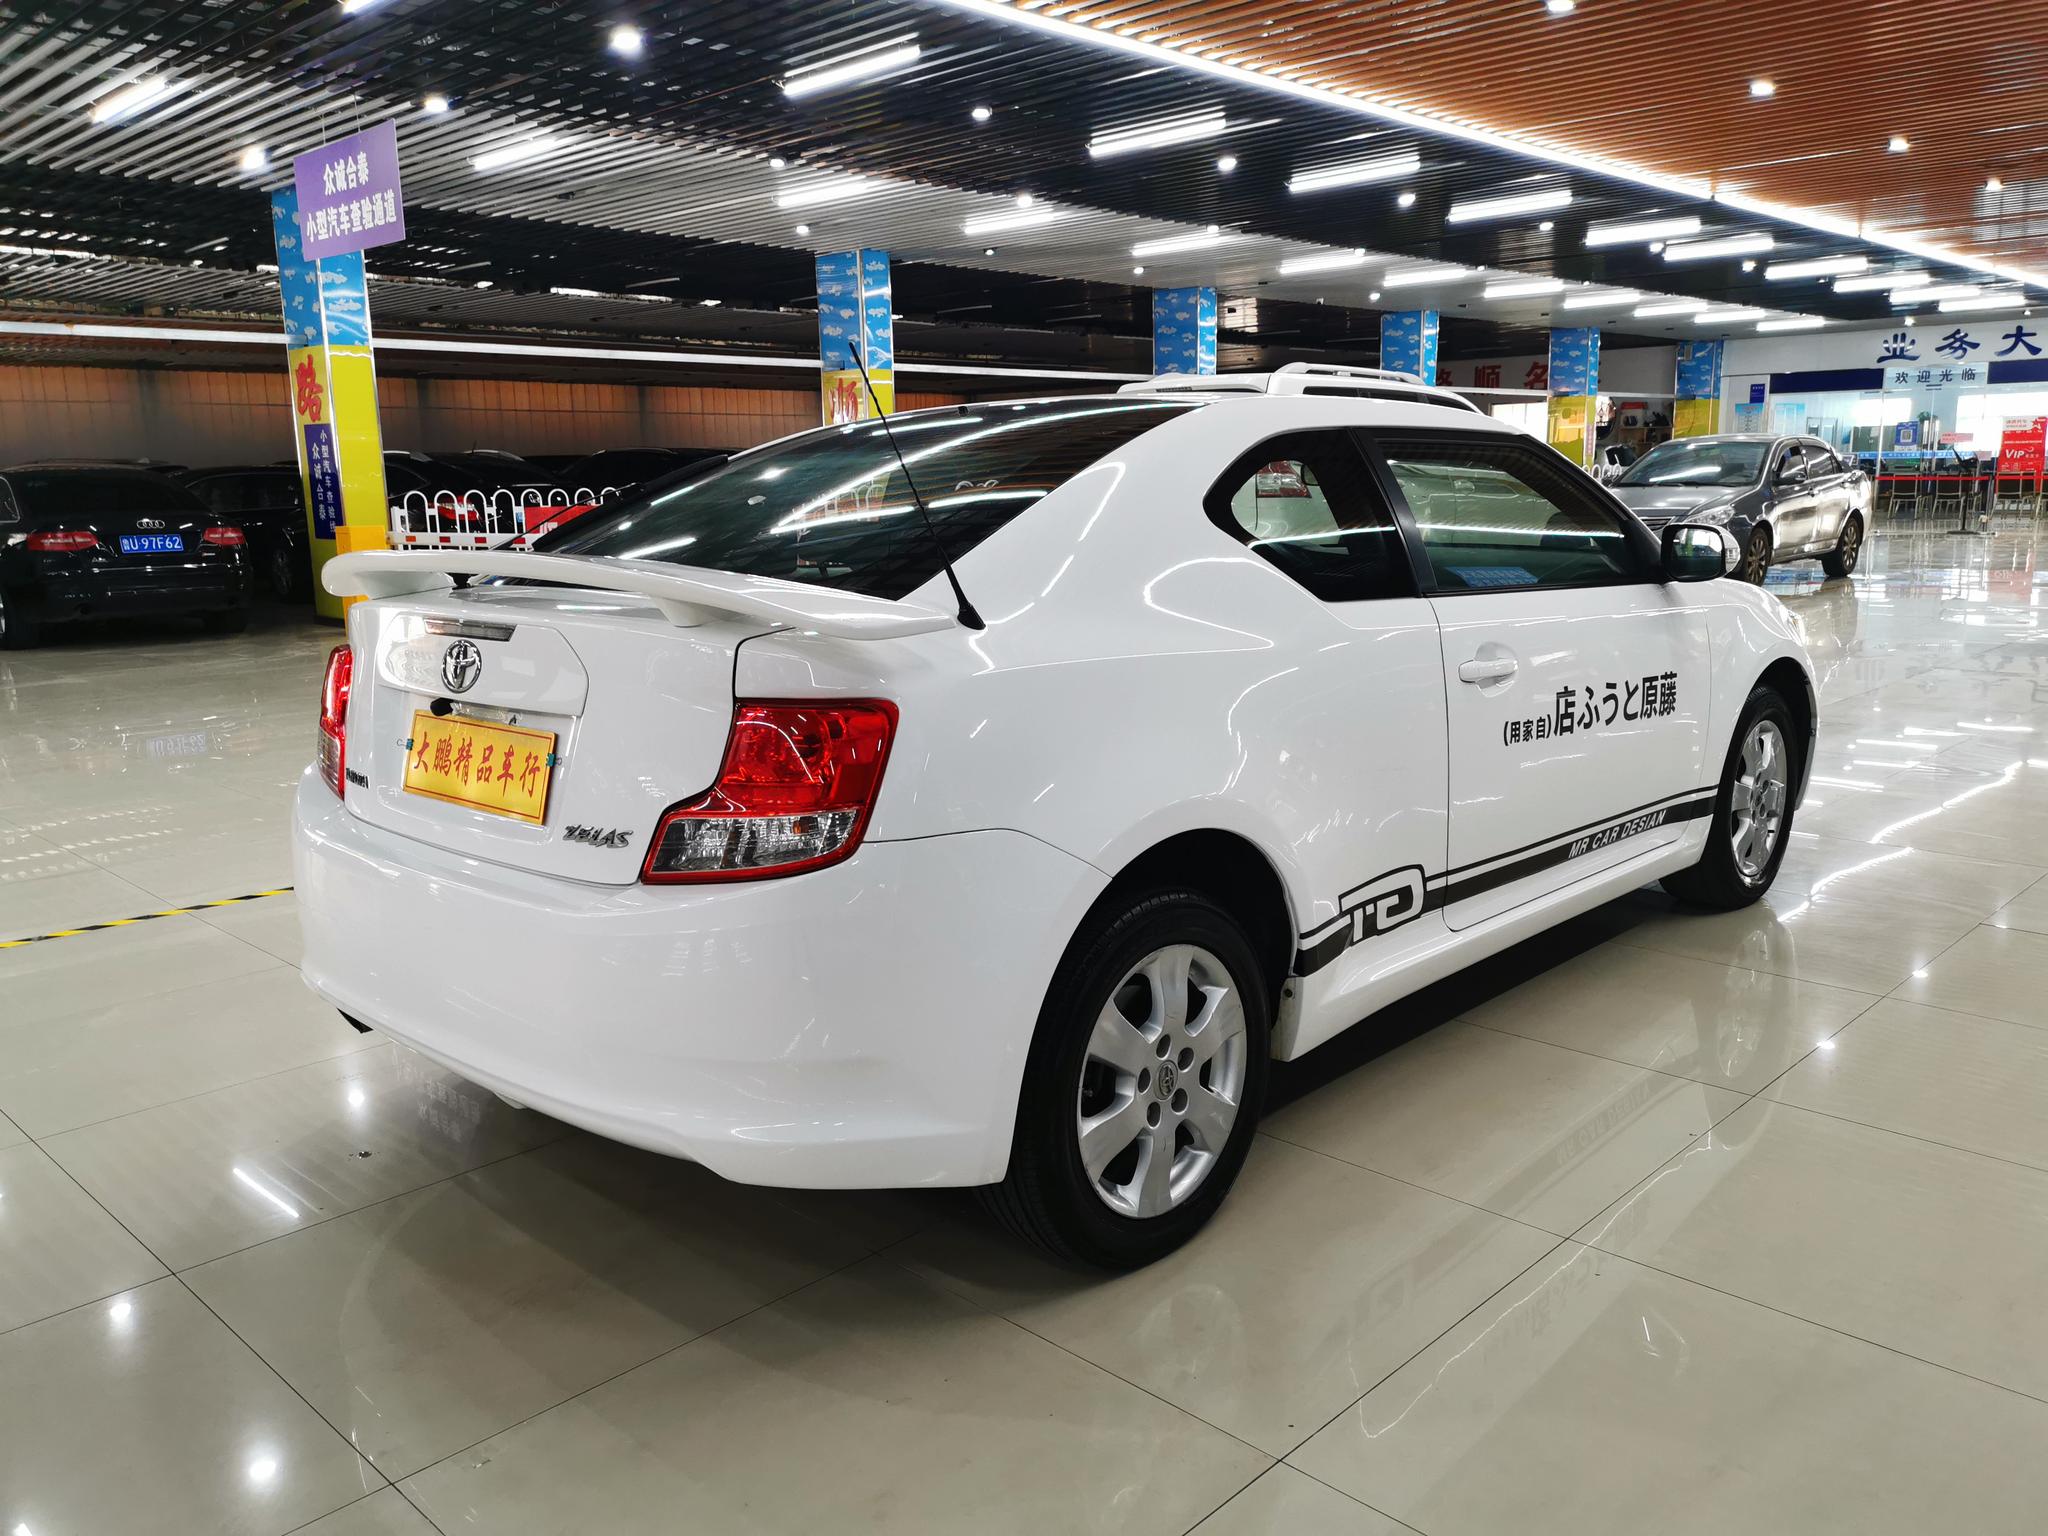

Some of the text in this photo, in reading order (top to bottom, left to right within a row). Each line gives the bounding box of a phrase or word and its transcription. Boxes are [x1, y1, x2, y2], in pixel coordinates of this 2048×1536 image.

[323, 151, 369, 196] 众诚合泰
[306, 188, 397, 243] 小型汽车查验通道
[1876, 325, 2043, 363] 业务大
[1895, 367, 1976, 384] 欢迎光临
[2005, 449, 2025, 459] VIP
[312, 442, 326, 520] 众诚合泰
[1568, 809, 1667, 859] MR CAR DESIAN
